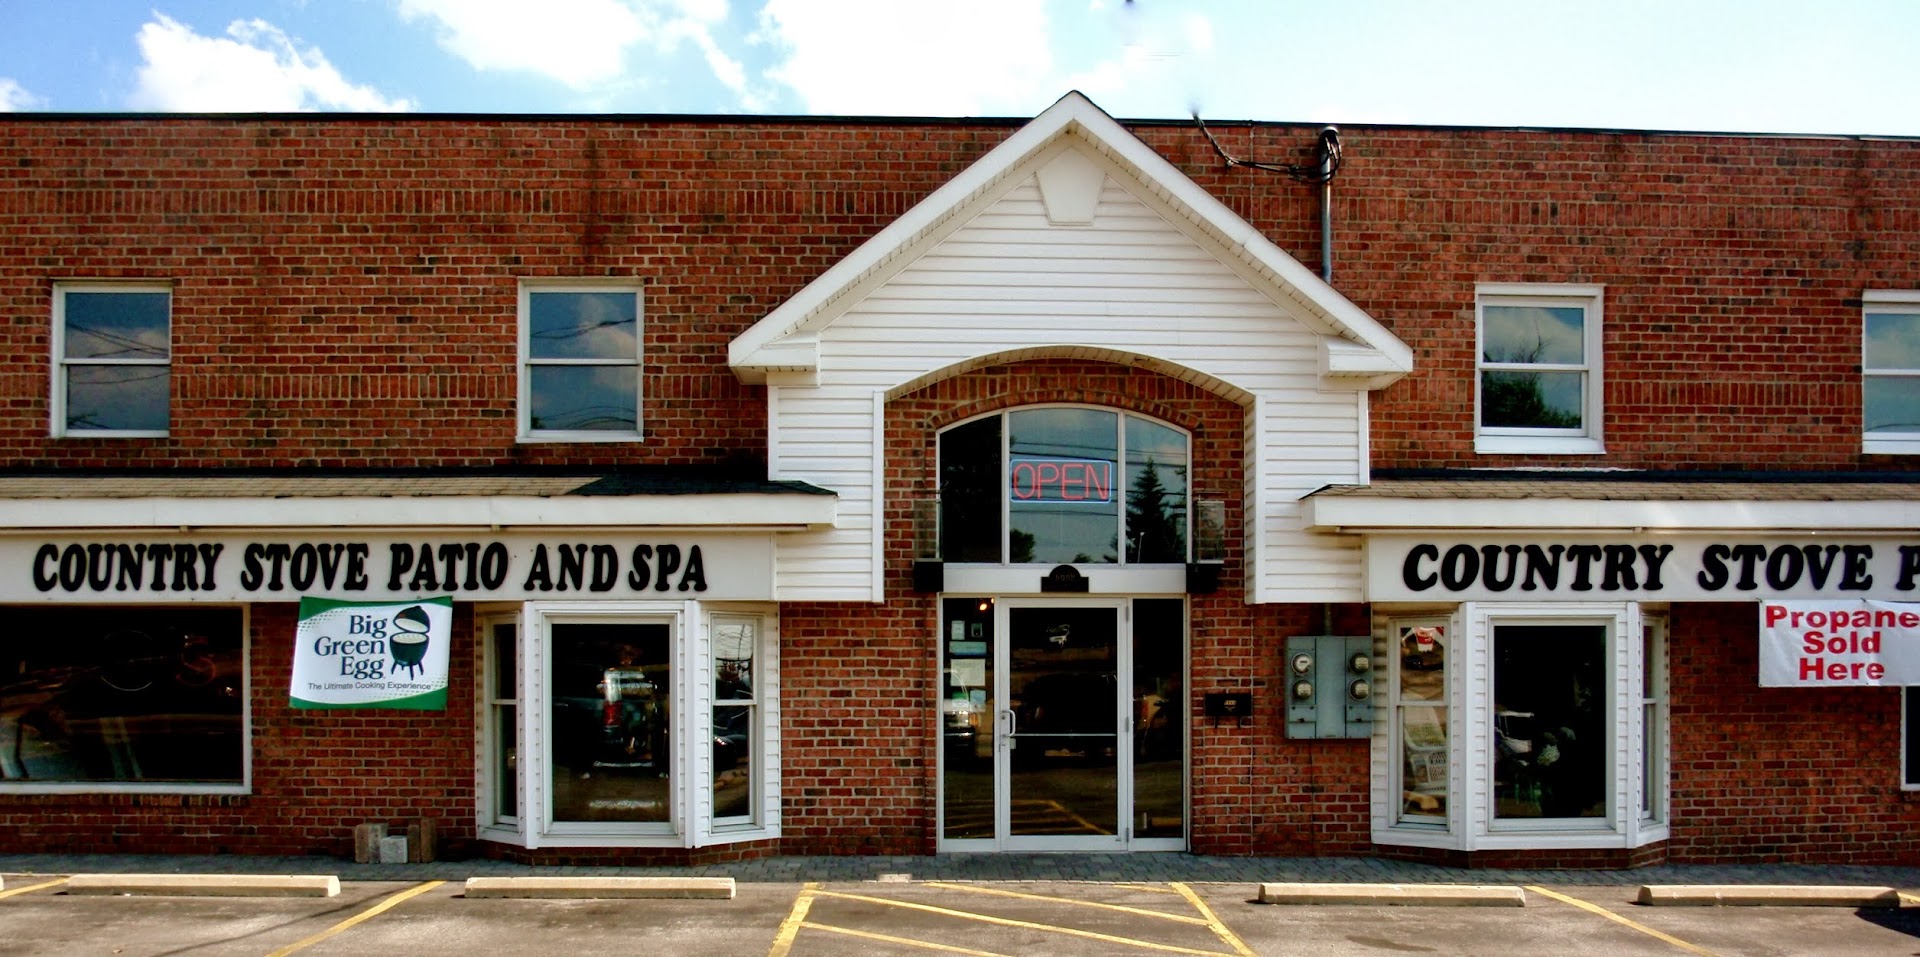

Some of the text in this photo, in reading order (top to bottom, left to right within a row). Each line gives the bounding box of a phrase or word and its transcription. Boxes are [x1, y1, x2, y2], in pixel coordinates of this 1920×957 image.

[1013, 463, 1109, 500] OPEN
[33, 542, 707, 592] COUNTRY STOVE PATIO AND SPA
[1402, 544, 1673, 592] COUNTRY
[1697, 544, 1873, 591] STOVE
[349, 615, 387, 639] Big
[1765, 605, 1920, 634] Propane
[314, 636, 386, 656] Green
[1803, 631, 1881, 654] Sold
[340, 656, 385, 680] Egg
[1799, 657, 1885, 681] Here
[308, 681, 432, 691] The Ultimate Cooking Experience
